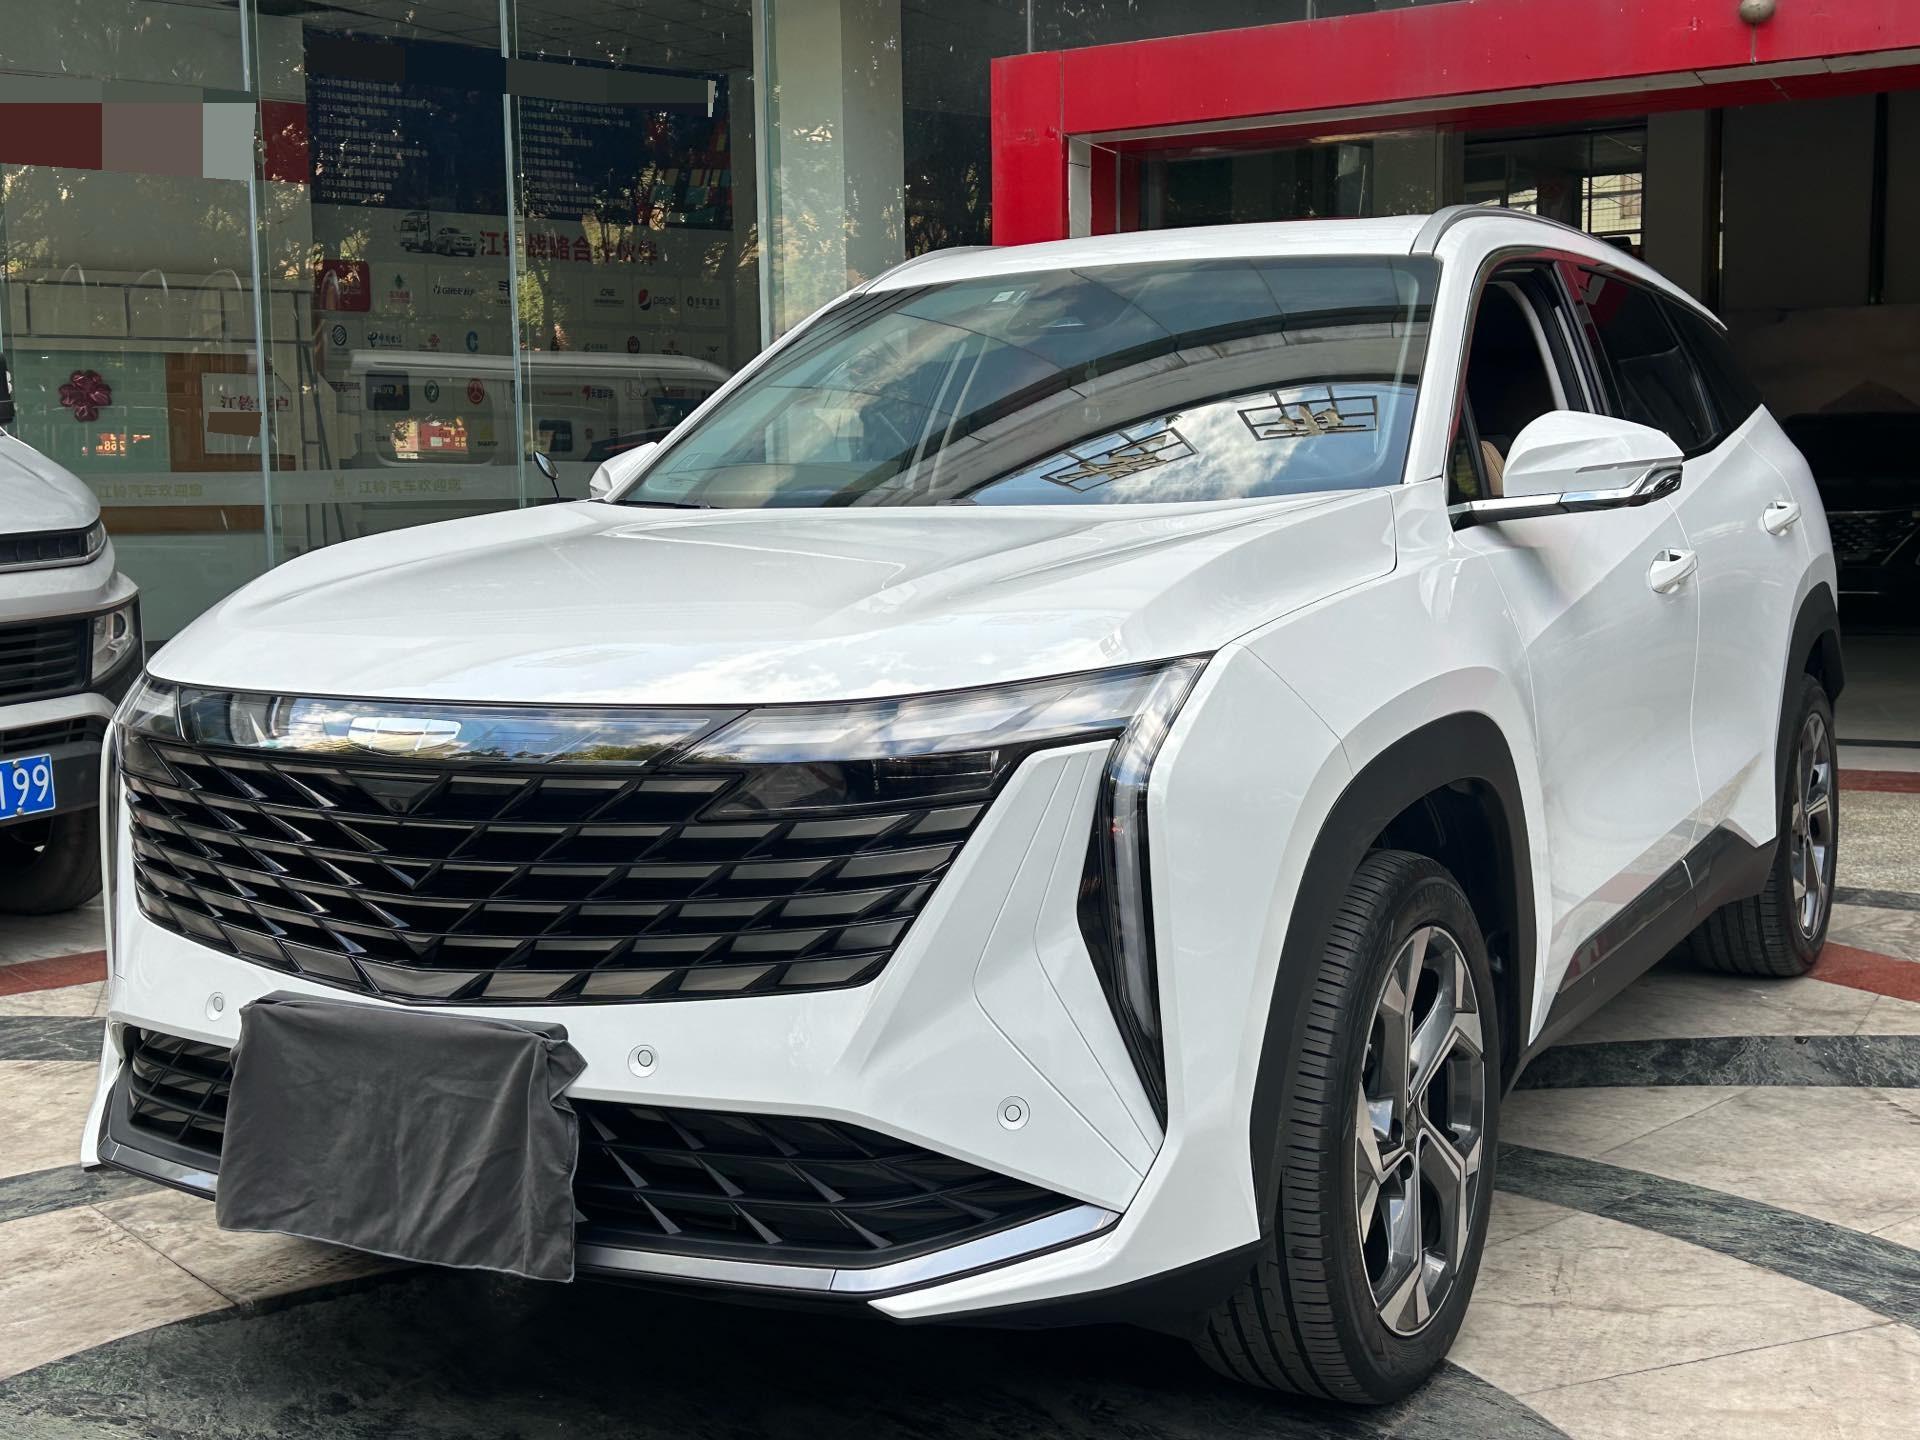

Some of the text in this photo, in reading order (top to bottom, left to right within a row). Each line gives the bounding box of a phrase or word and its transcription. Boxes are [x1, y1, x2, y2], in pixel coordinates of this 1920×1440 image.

[220, 394, 289, 411] 江铃户
[359, 479, 463, 495] 江铃汽车欢迎您
